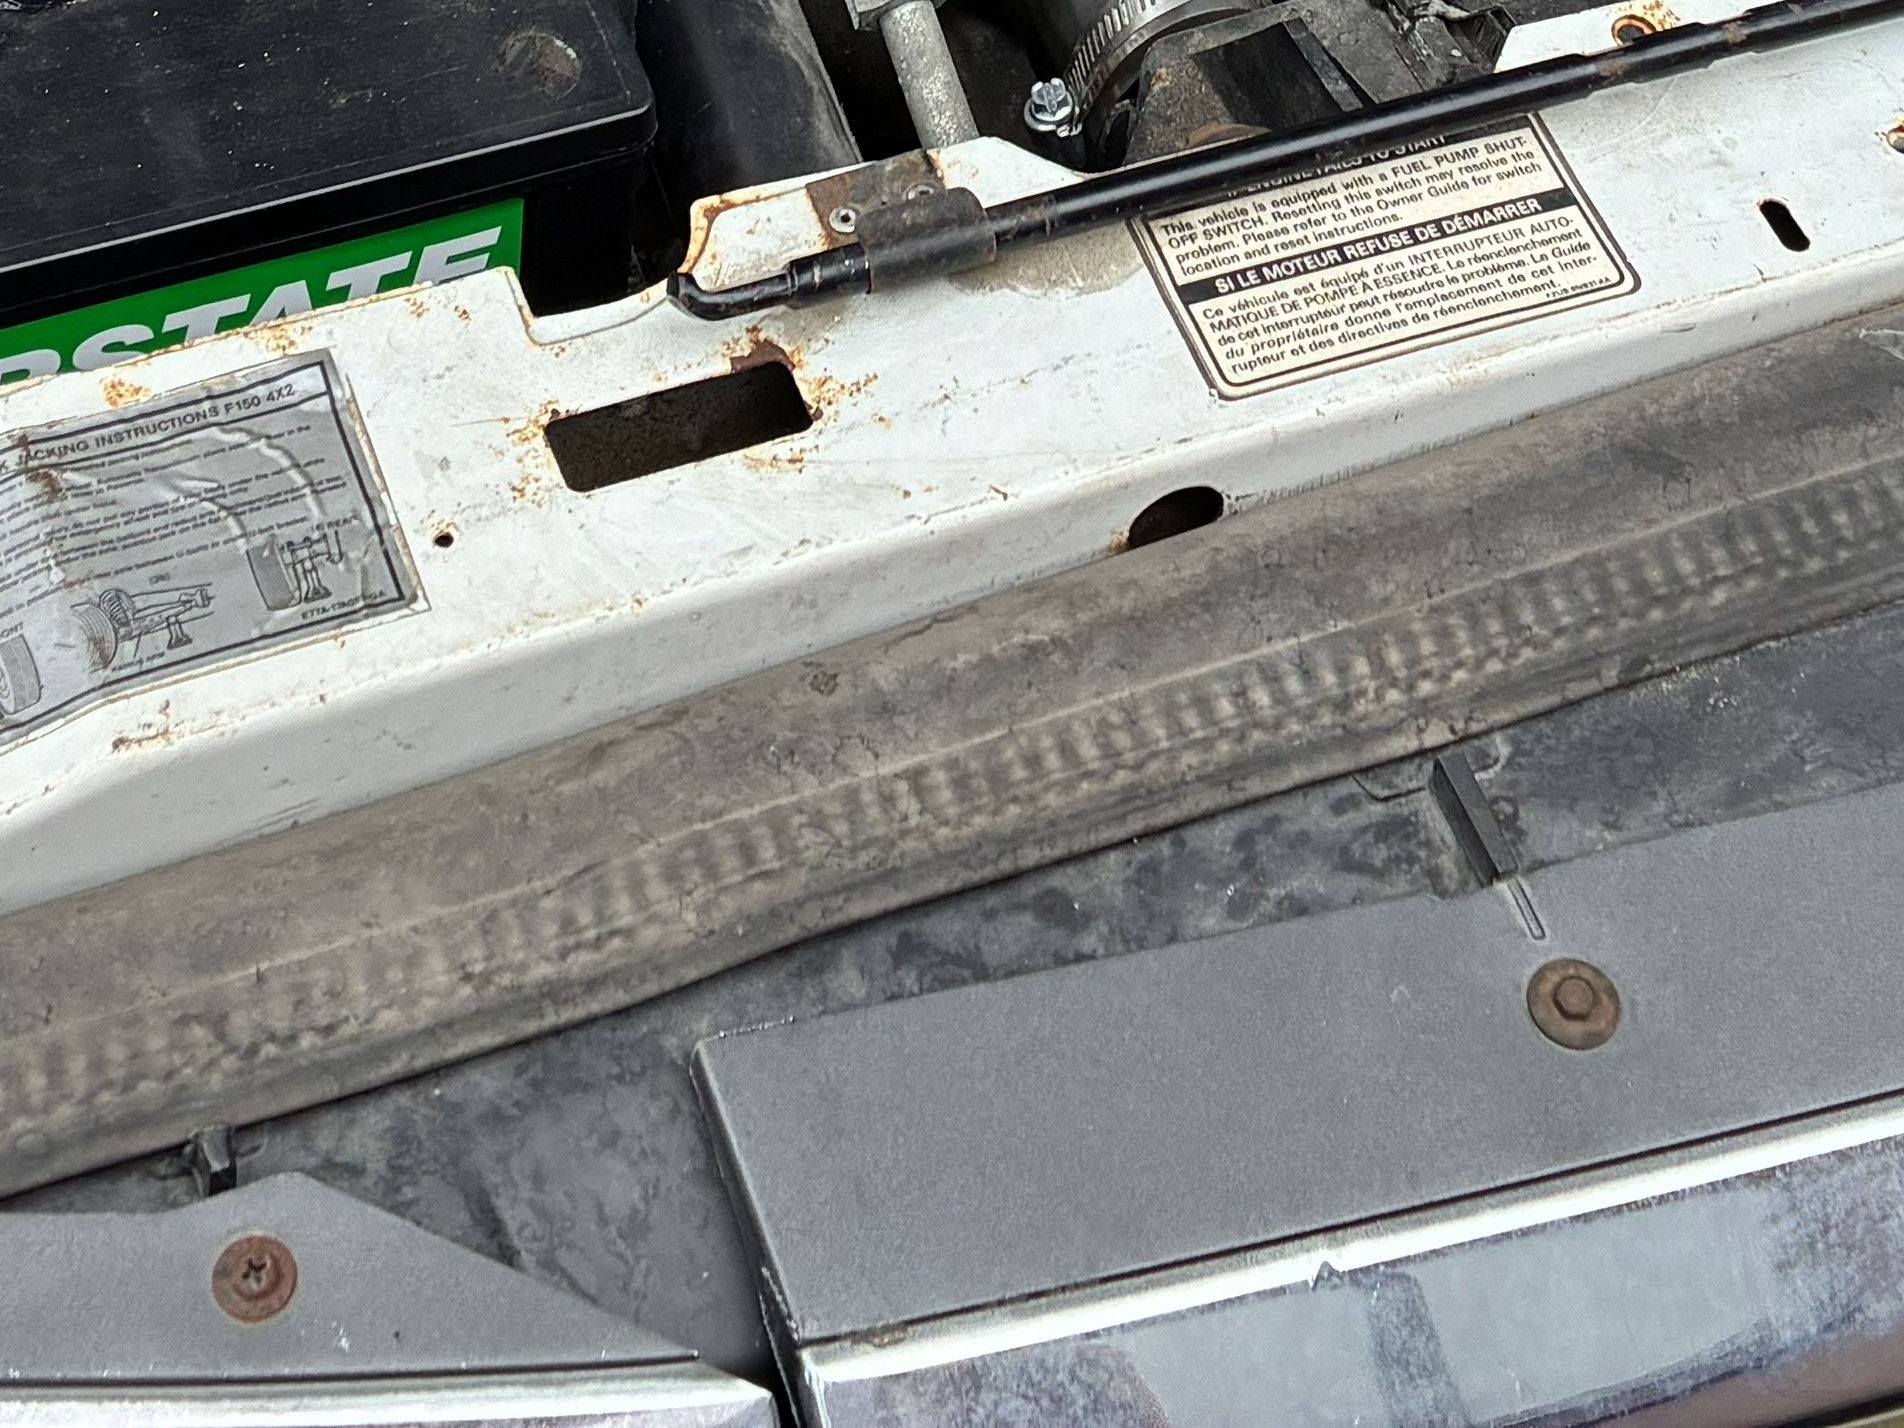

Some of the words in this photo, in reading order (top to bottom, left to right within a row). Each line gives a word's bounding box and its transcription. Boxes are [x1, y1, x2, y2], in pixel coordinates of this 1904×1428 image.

[1158, 216, 1195, 236] This
[1195, 203, 1251, 227] vehicle
[1250, 198, 1270, 213] is
[1267, 181, 1340, 212] equipped
[1339, 172, 1374, 192] with
[1389, 157, 1433, 179] FUEL
[1432, 145, 1482, 168] PUMP
[1165, 230, 1202, 250] OFF
[1200, 214, 1270, 241] SWITCH.
[1270, 195, 1343, 225] Resetting
[1342, 188, 1372, 206] this
[1372, 175, 1422, 198] switch
[1423, 168, 1457, 187] may
[1456, 154, 1510, 177] resolve
[1509, 147, 1536, 164] the
[1171, 235, 1243, 265] problem.
[1240, 223, 1291, 246] Please
[1290, 213, 1330, 234] refer
[1329, 209, 1348, 223] to
[1347, 202, 1376, 219] the
[1375, 189, 1426, 212] Owner
[1426, 178, 1471, 199] Guide
[1469, 172, 1494, 189] for
[1493, 161, 1543, 183] switch
[1178, 250, 1242, 277] location
[1240, 242, 1272, 260] and
[1271, 233, 1312, 253] reset
[1311, 210, 1405, 243] instructions.
[1199, 304, 1225, 321] Ce
[1225, 286, 1292, 313] véhicule
[1290, 280, 1316, 296] est
[1317, 265, 1372, 291] équipé
[1369, 256, 1406, 275] d'un
[1405, 226, 1527, 267] INTERRUPTEUR
[1207, 305, 1281, 334] MATIQUE
[1280, 299, 1303, 314] DE
[1302, 284, 1360, 308] POMPE
[1371, 262, 1448, 290] ESSENCE.
[1446, 257, 1466, 271] Le
[1465, 226, 1584, 266] réenclenchement
[1212, 275, 1237, 294] SI
[1233, 268, 1262, 288] LE
[1259, 248, 1343, 281] MOTEUR
[1341, 230, 1415, 260] REFUSE
[1412, 222, 1443, 242] DE
[1438, 194, 1544, 235] DÉMARRER
[1214, 331, 1237, 347] de
[1234, 324, 1262, 341] cet
[1258, 301, 1350, 337] interrupteur
[1346, 294, 1382, 313] peut
[1379, 275, 1446, 302] résoudre
[1444, 271, 1462, 286] le
[1528, 249, 1550, 264] Le
[1548, 237, 1593, 259] Guide
[1221, 343, 1248, 360] du
[1245, 317, 1343, 356] propriétaire
[1340, 304, 1393, 327] donne
[1393, 275, 1507, 316] l'emplacement
[1504, 269, 1528, 285] de
[1528, 263, 1556, 279] cet
[1227, 348, 1289, 375] rupteur
[1287, 342, 1307, 356] et
[1305, 334, 1336, 352] des
[1334, 314, 1410, 343] directives
[1408, 308, 1431, 324] de
[94, 406, 220, 451] INSTRUCTIONS
[223, 394, 262, 419] F150
[265, 383, 296, 404] 4X2
